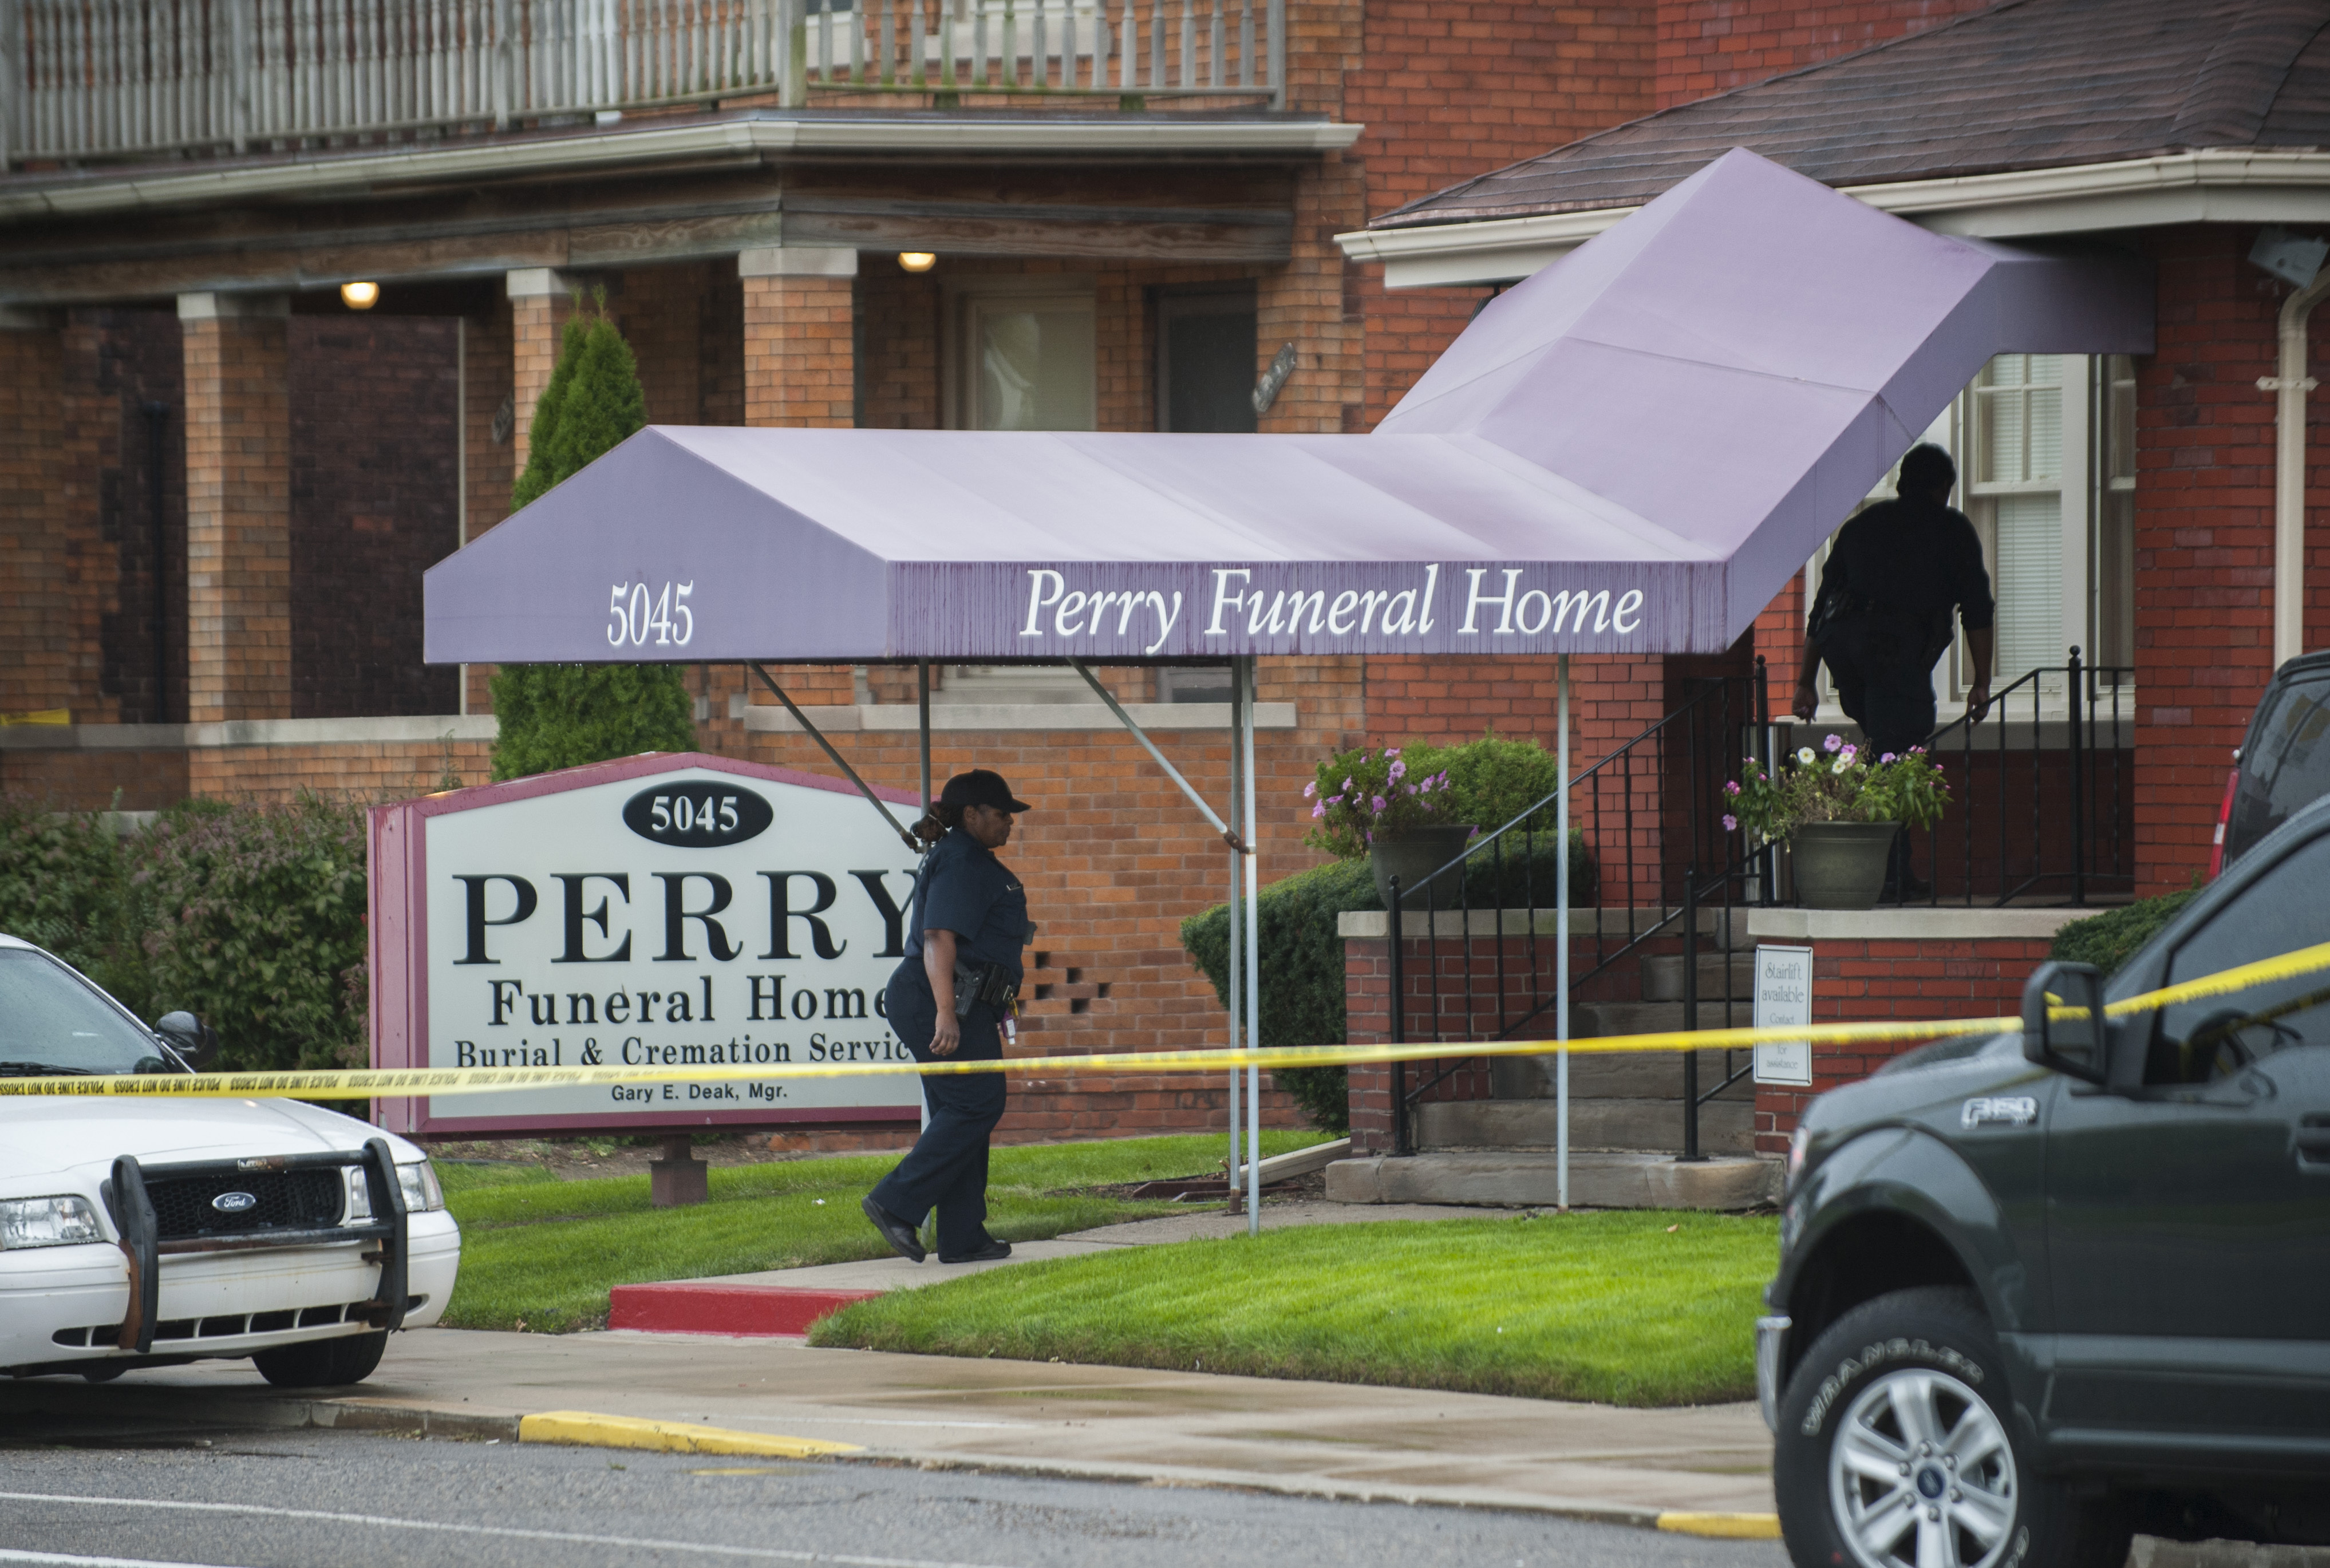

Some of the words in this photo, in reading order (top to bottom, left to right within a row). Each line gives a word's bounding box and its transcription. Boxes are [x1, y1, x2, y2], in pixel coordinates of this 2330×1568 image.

[607, 579, 693, 646] 5045
[1020, 568, 1182, 655] Perry
[1205, 563, 1439, 634] Funeral
[1458, 568, 1644, 634] Home
[650, 795, 739, 832] 5045
[451, 869, 918, 964] PERRY
[1765, 962, 1802, 980] Stairlift
[487, 974, 716, 1026] Funeral
[1762, 985, 1804, 1004] available
[1770, 1012, 1796, 1026] Contact
[454, 1037, 562, 1068] Burial
[580, 1037, 603, 1065] &
[622, 1034, 792, 1065] Cremation
[809, 1032, 910, 1061] Servic
[611, 1084, 653, 1103] Gary
[663, 1084, 680, 1100] E.
[689, 1083, 740, 1100] Deak,
[749, 1083, 788, 1101] Mgr.
[224, 1196, 246, 1208] Ford
